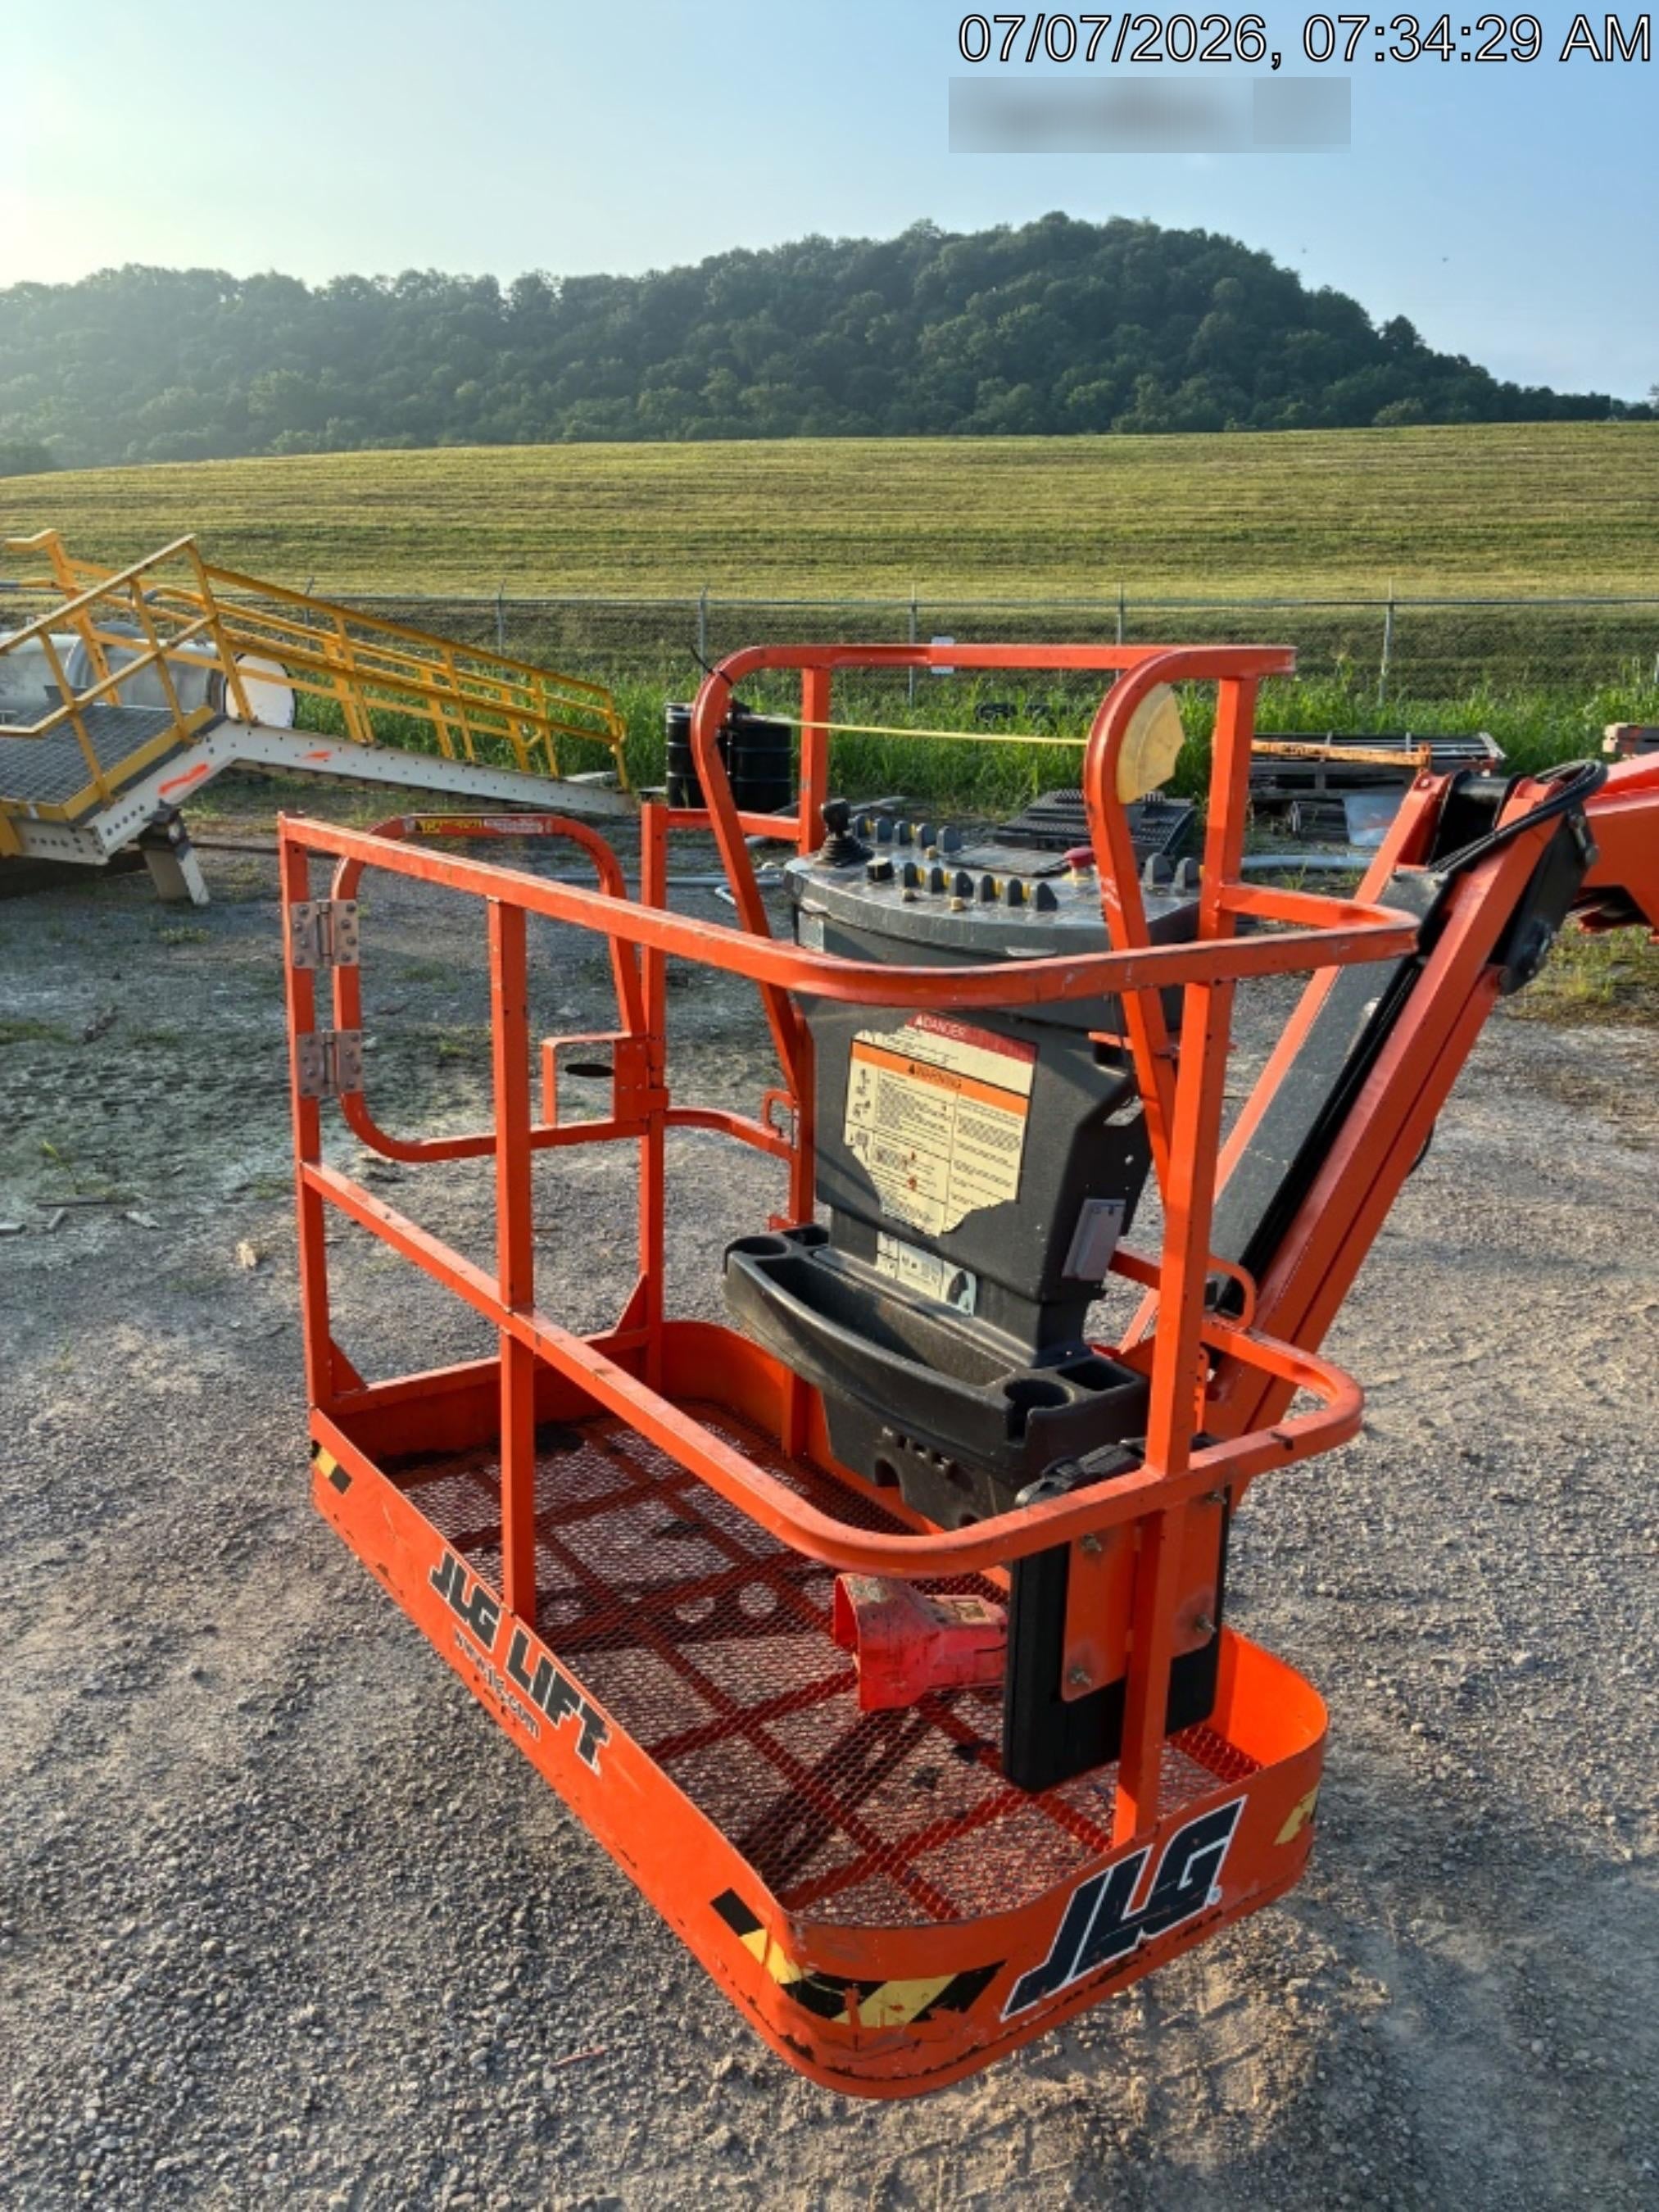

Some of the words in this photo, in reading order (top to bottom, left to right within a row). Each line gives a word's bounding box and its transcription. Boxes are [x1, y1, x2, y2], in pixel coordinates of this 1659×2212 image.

[921, 1017, 967, 1038] DANGER
[428, 1548, 501, 1652] JLG
[504, 1621, 612, 1776] LIFT
[999, 1794, 1249, 2023] JLG
